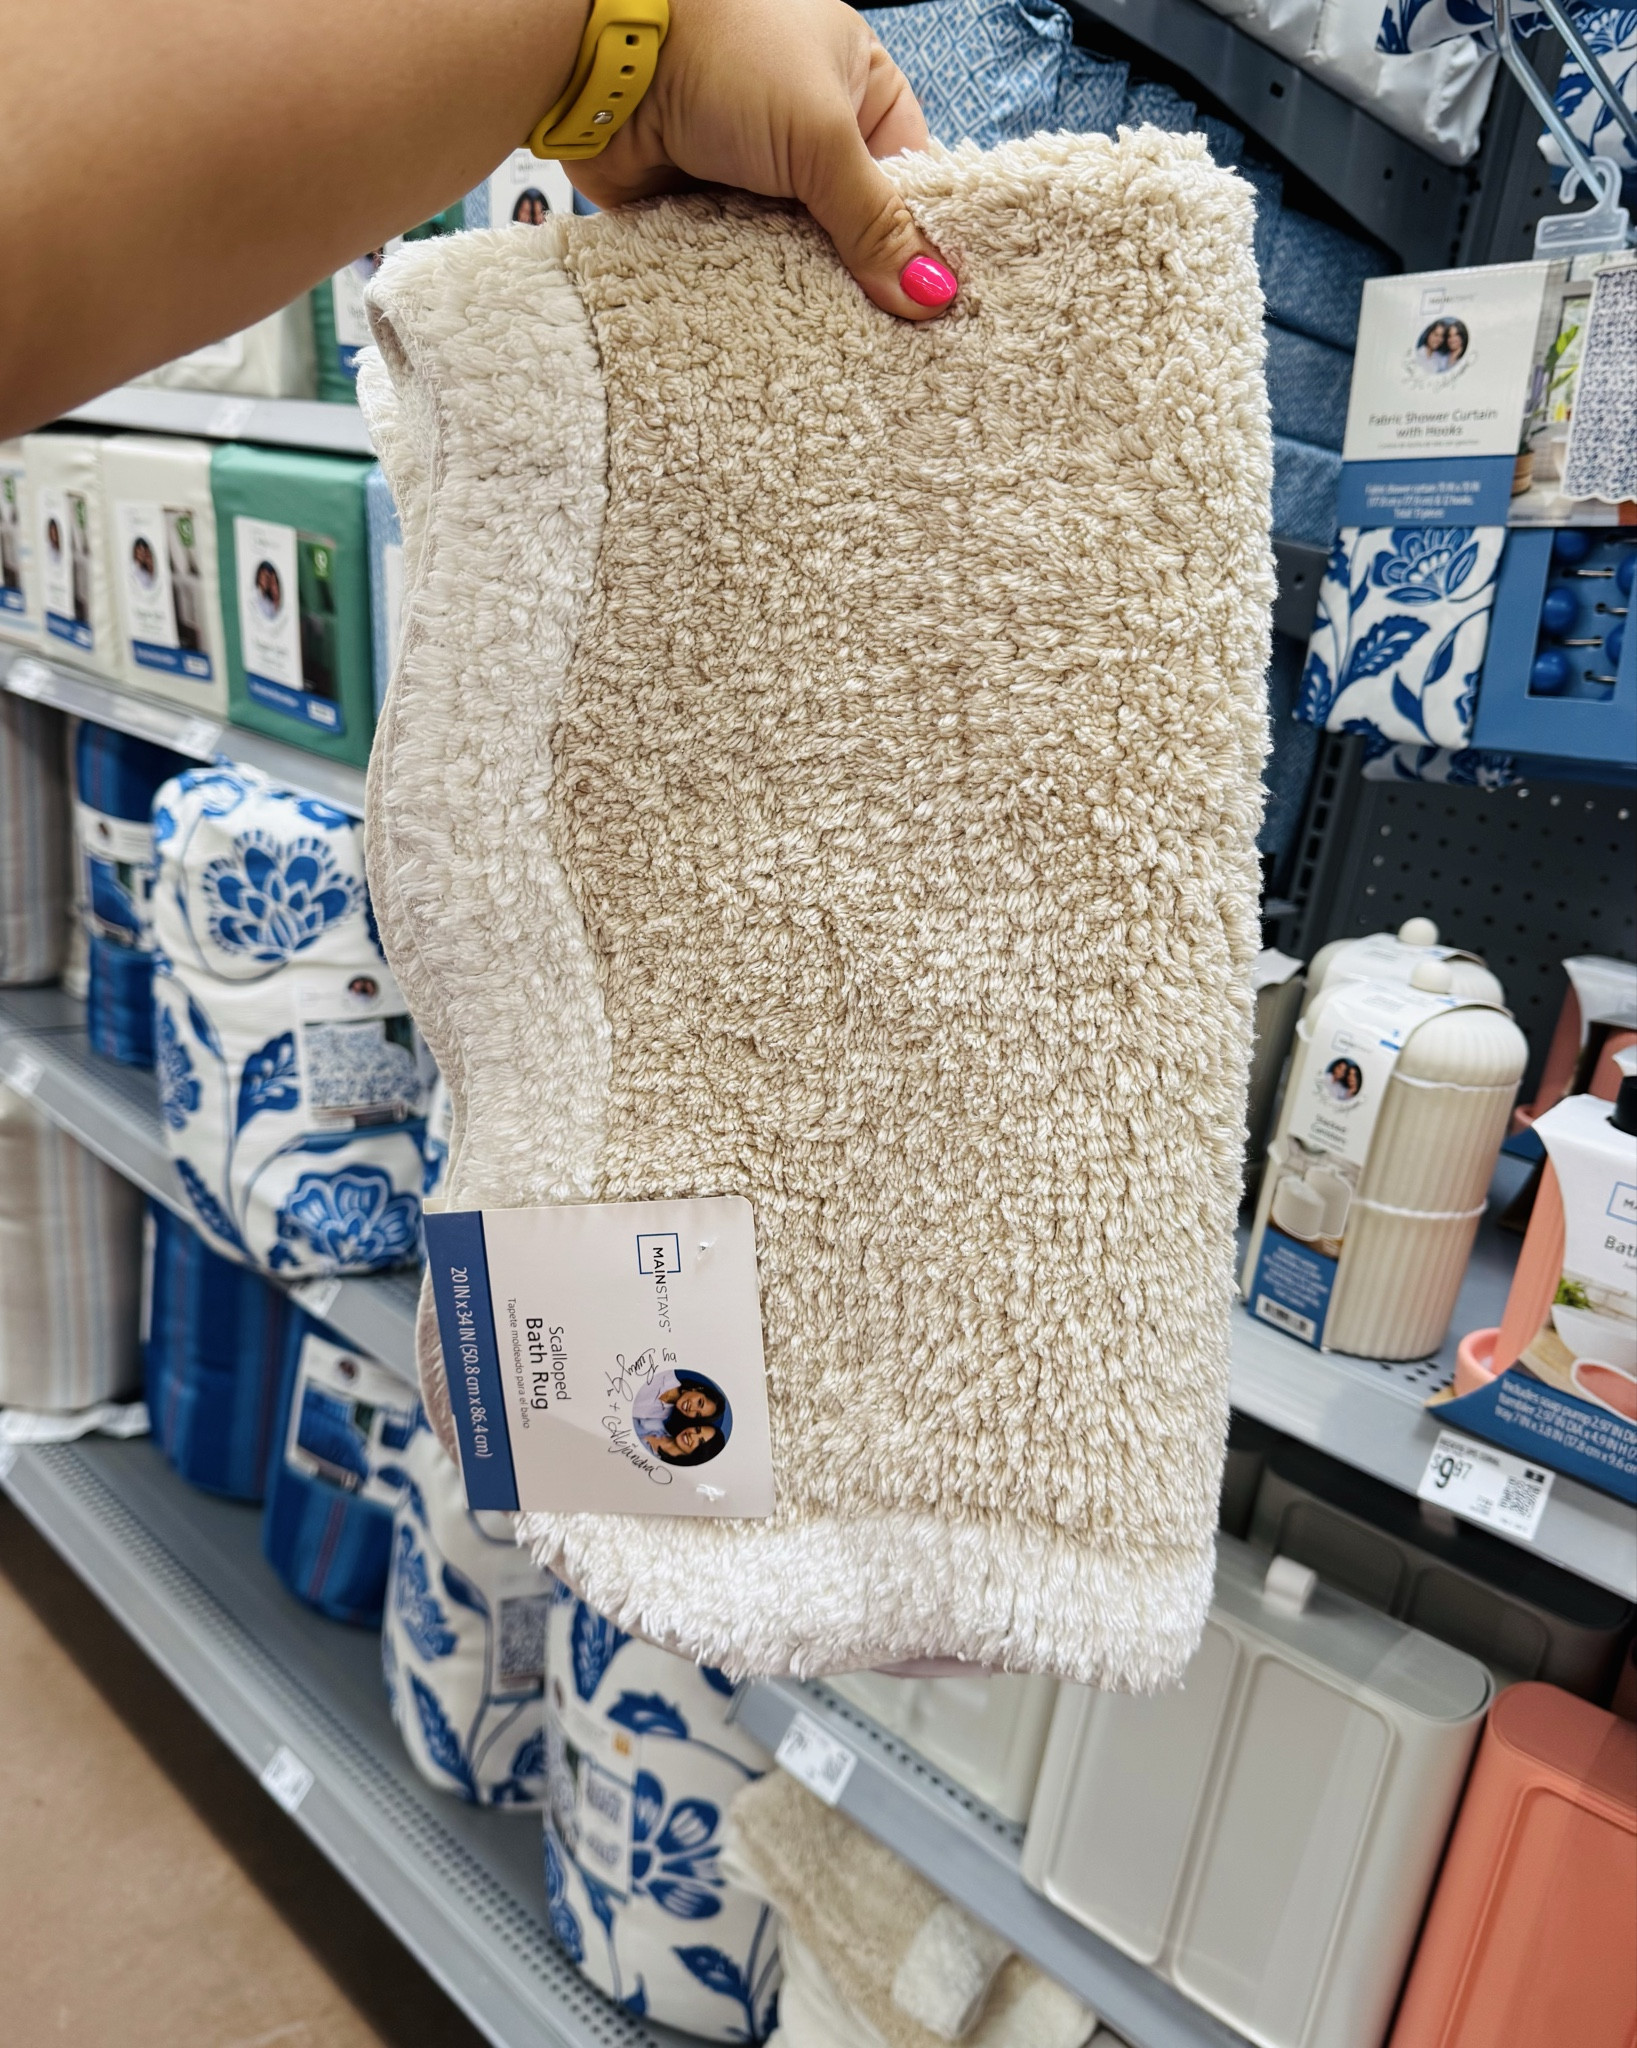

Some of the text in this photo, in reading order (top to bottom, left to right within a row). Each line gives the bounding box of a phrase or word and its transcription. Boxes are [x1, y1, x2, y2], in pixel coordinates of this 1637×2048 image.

[1406, 410, 1449, 424] Shower
[1452, 408, 1498, 422] Curtain
[1397, 424, 1463, 438] with Hooks
[450, 1267, 468, 1284] 20
[454, 1286, 471, 1298] IN
[653, 1247, 671, 1328] MAINSTAYS
[457, 1310, 475, 1326] 34
[460, 1328, 476, 1340] IN
[459, 1343, 482, 1374] (50.8
[507, 1298, 531, 1428] Tapete moldeado para el baño
[526, 1318, 550, 1410] Bath Rug
[549, 1326, 571, 1400] Scalloped
[466, 1377, 479, 1394] cm
[471, 1407, 487, 1432] 86.4
[473, 1435, 493, 1457] cm)
